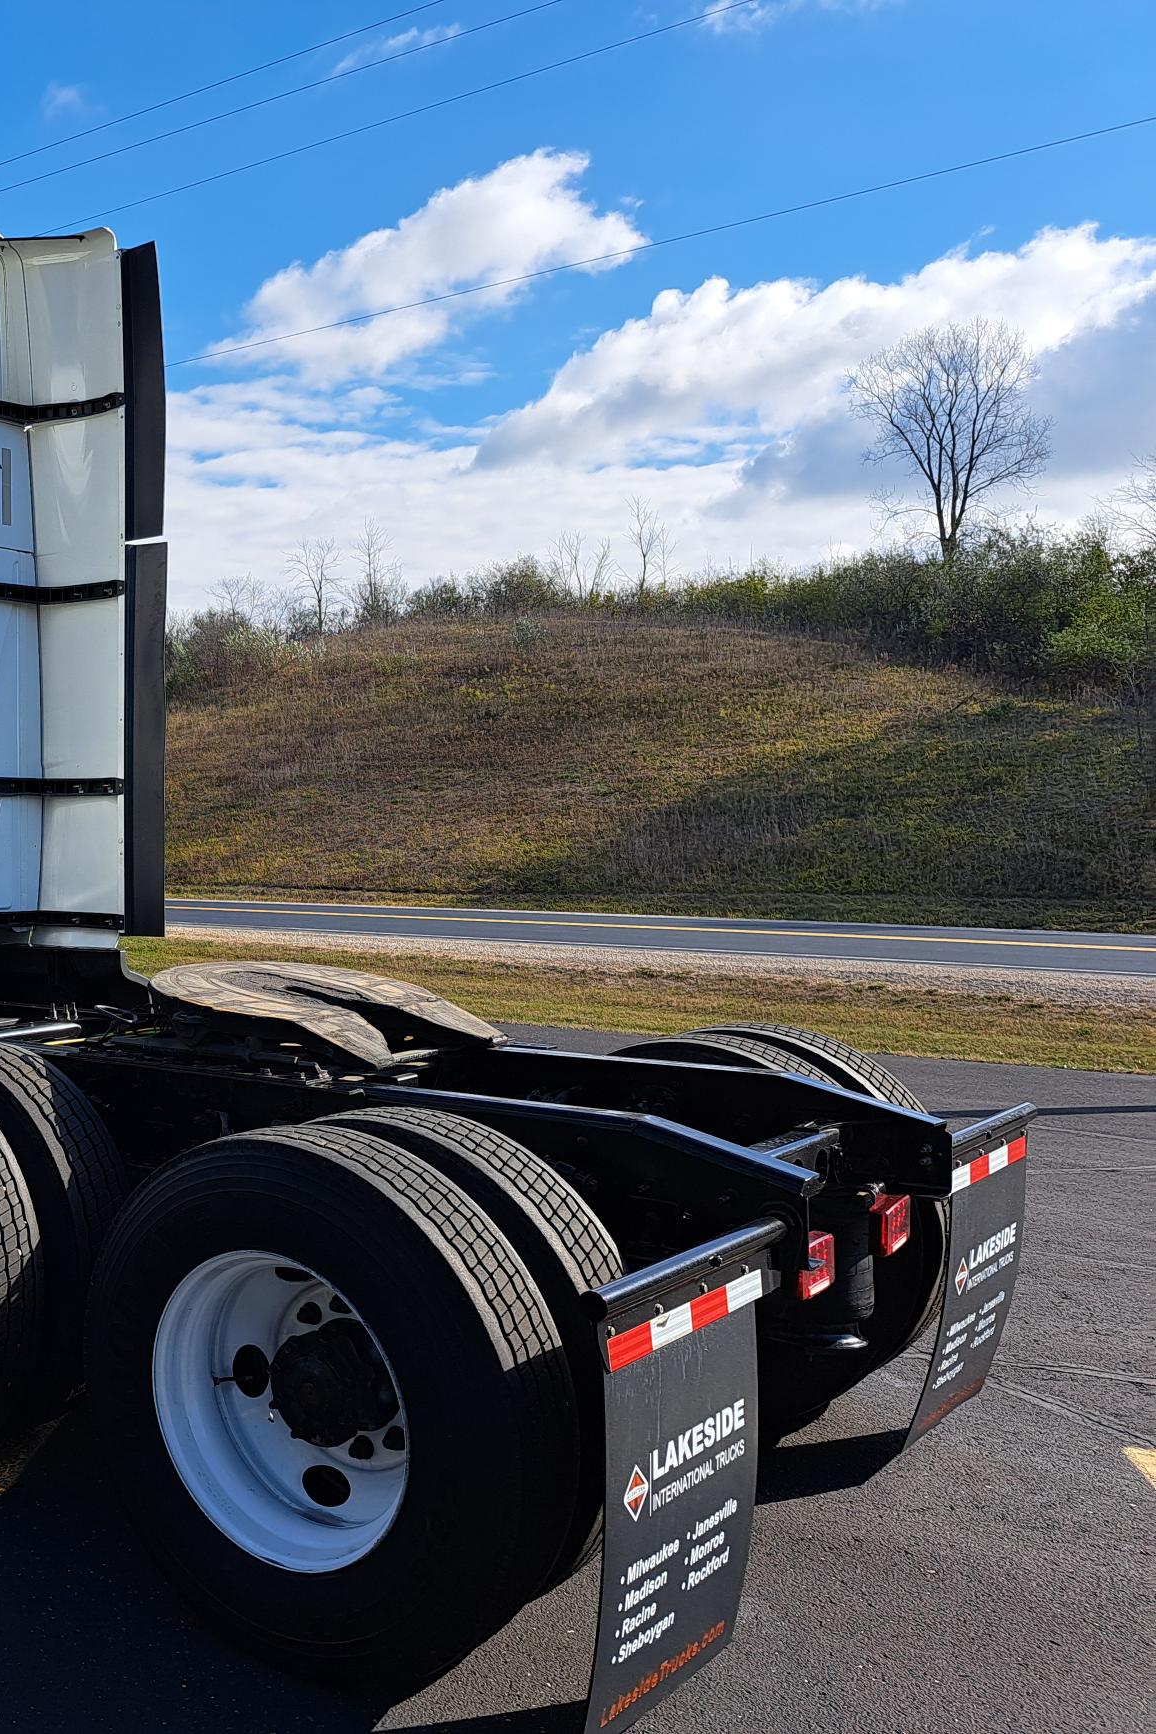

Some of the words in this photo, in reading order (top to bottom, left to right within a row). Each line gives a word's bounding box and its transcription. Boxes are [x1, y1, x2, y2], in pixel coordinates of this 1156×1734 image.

[969, 1221, 1017, 1270] LAKESIDE
[652, 1398, 745, 1480] LAKESIDE
[652, 1458, 715, 1512] INTERNATIONAL
[715, 1438, 745, 1471] TRUCKS
[692, 1498, 738, 1540] Janesville
[627, 1539, 680, 1585] Milwaukee
[687, 1546, 730, 1590] Rockford
[690, 1531, 725, 1566] Monroe
[624, 1571, 668, 1611] Madison
[618, 1611, 675, 1663] Sheboygan
[621, 1602, 657, 1638] Racine
